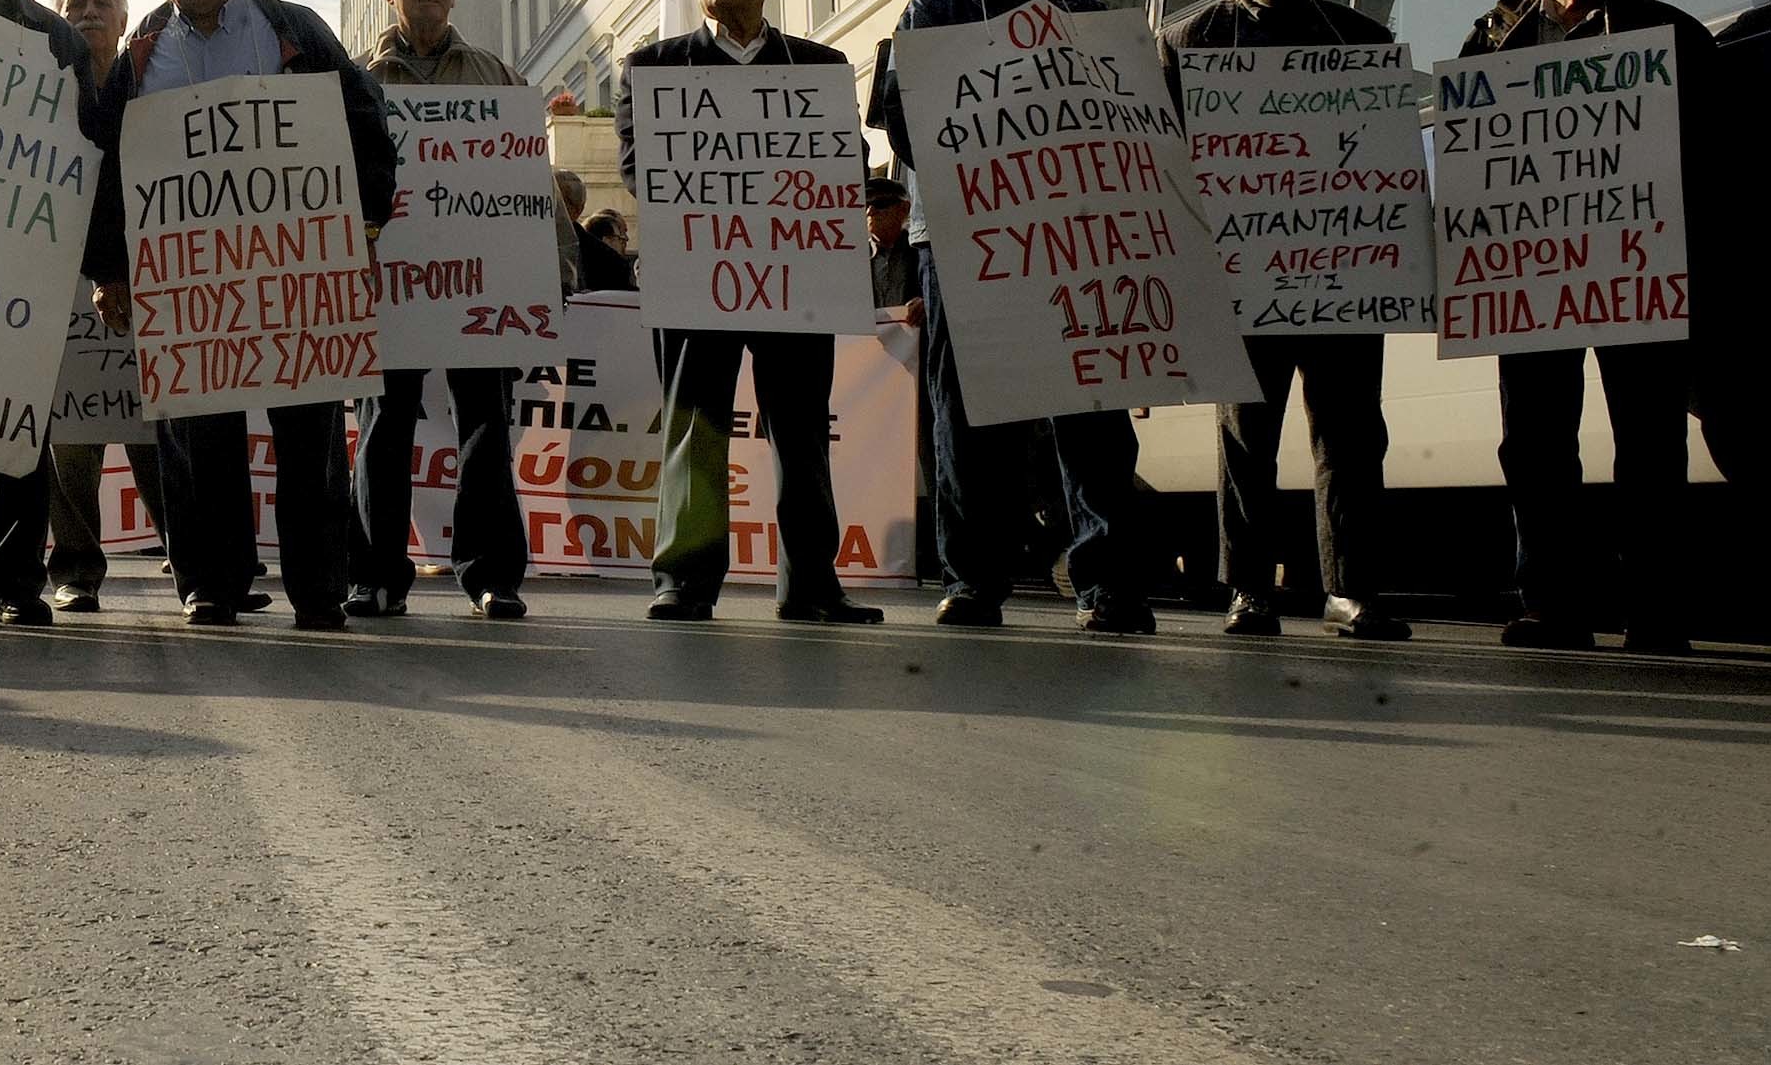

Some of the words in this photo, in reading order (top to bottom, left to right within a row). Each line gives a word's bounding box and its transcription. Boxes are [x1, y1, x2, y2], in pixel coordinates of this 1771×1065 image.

[1181, 52, 1254, 72] ΣΤΗΝ
[1282, 47, 1401, 73] ΕΠΙΘΕΣΗ
[653, 87, 721, 119] ΓΙΑ
[752, 88, 825, 119] ΤΙΣ
[1187, 88, 1242, 116] ΠΟΥ
[1259, 84, 1416, 115] ΔΕΧΟΜΑΣΤΕ
[1440, 70, 1496, 111] ΝΔ
[184, 100, 298, 159] ΕΙΣΤΕ
[1443, 95, 1641, 154] ΣΙΩΠΟΥΝ
[418, 137, 458, 163] ΓΙΑ
[463, 139, 495, 159] ΤΟ
[500, 131, 546, 161] 2010
[654, 130, 856, 161] ΤΡΑΠΕΖΕΣ
[1192, 132, 1310, 162] ΕΡΓΑΤΕΣ
[1195, 169, 1426, 198] ΣΥΝΤΑΞΙΟΥΧΟΙ
[1485, 154, 1540, 189] ΓΙΑ
[1553, 144, 1621, 181] ΤΗΝ
[135, 165, 342, 229] ΥΠΟΛΟΓΟΙ
[646, 169, 764, 205] ΕΧΕΤΕ
[1215, 204, 1407, 244] ΑΠΑΝΤΑΜΕ
[1444, 181, 1655, 242] ΚΑΤΑΡΓΗΣΗ
[133, 214, 354, 286] ΑΠΕΝΑΝΤΙ
[683, 214, 753, 251] ΓΙΑ
[771, 217, 856, 250] ΜΑΣ
[972, 209, 1175, 281] ΣΥΝΤΑΞΗ
[1265, 243, 1400, 273] ΑΠΕΡΓΙΑ
[134, 280, 250, 336] ΣΤΟΥΣ
[257, 268, 376, 329] ΕΡΓΑΤΕΣ
[711, 260, 789, 312] ΟΧΙ
[1275, 274, 1343, 290] ΣΤΙΣ
[461, 305, 558, 339] ΣΑΣ
[1049, 275, 1174, 342] 1120
[1443, 289, 1546, 340] ΕΠΙΔ.
[1553, 273, 1689, 330] ΑΔΕΙΑΣ
